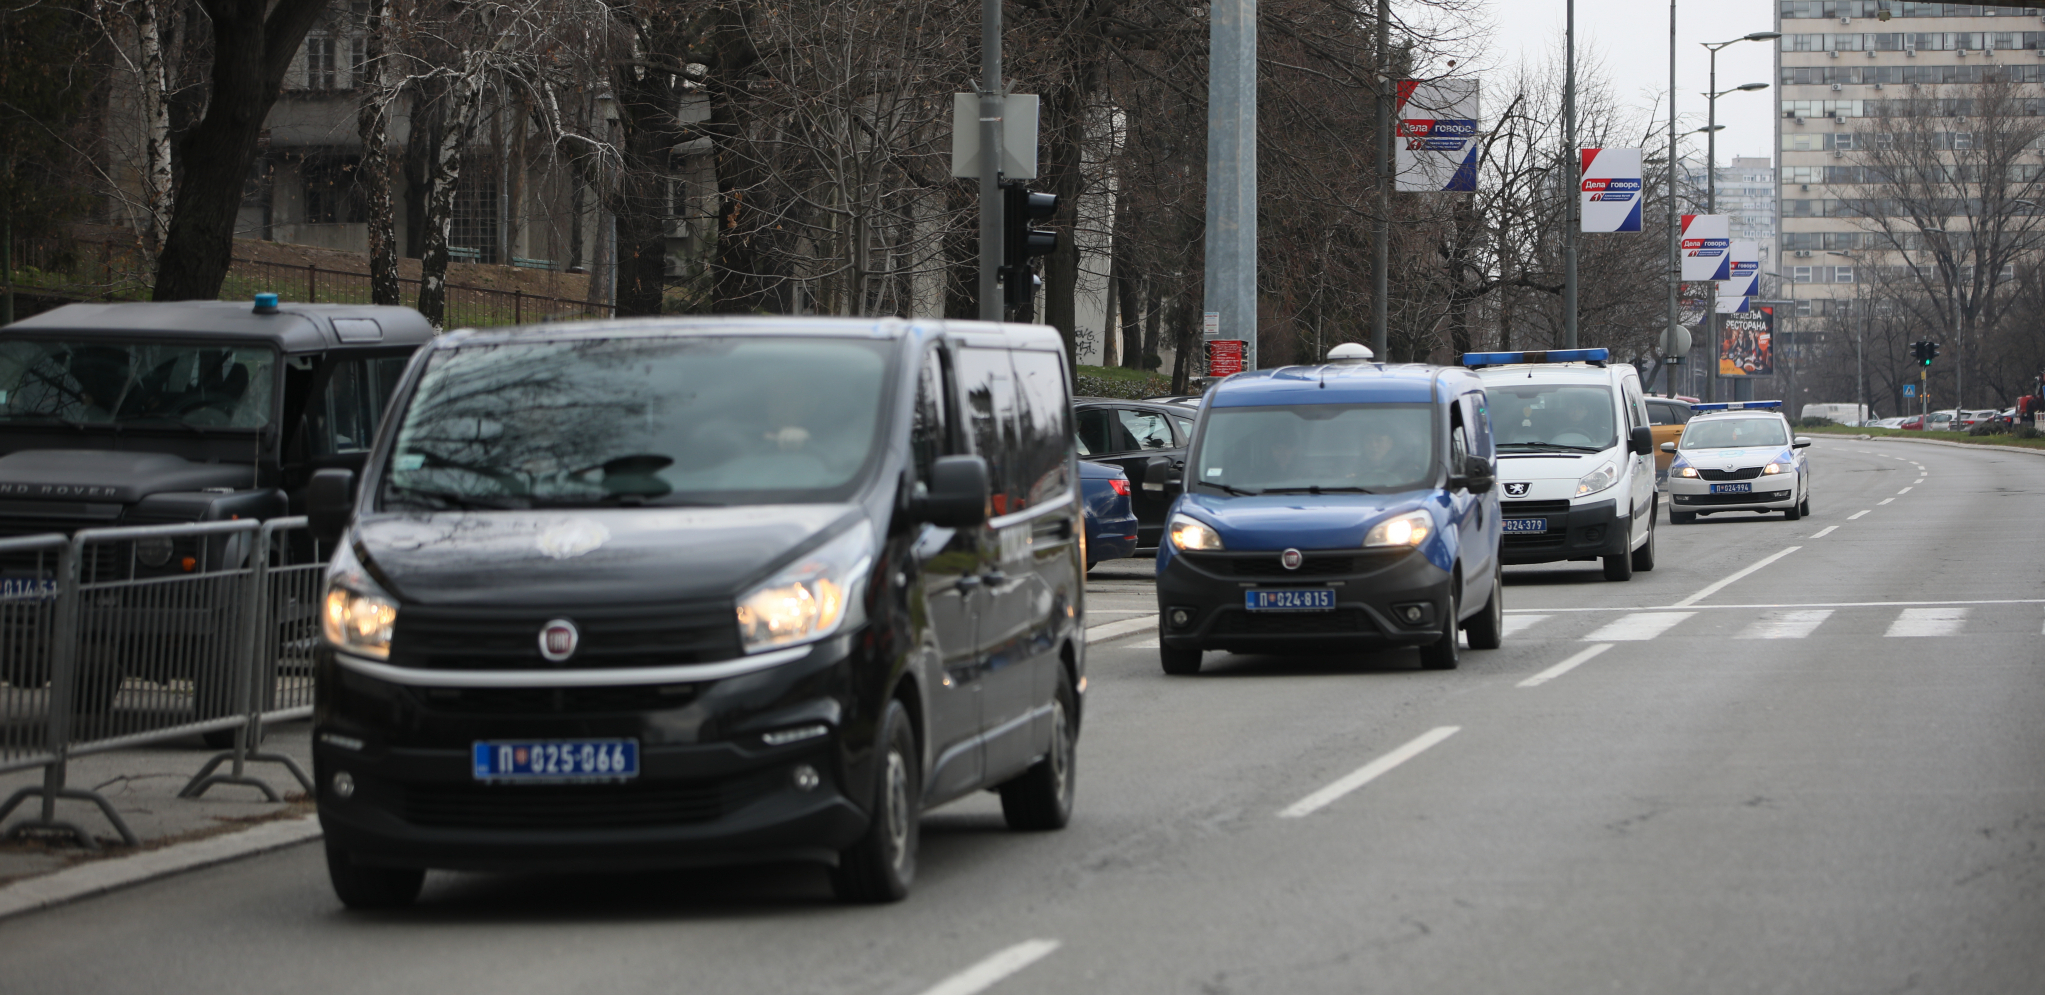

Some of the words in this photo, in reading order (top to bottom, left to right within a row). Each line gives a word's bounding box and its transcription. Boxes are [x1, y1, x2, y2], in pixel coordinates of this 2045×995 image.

[1401, 123, 1428, 133] Дела
[1585, 181, 1606, 189] Дела
[1704, 240, 1728, 248] говоре.
[1726, 320, 1766, 331] РЕСТОРАНА
[0, 484, 29, 493] ND
[41, 485, 117, 496] ROVER
[1724, 484, 1749, 492] 024-994
[1507, 520, 1542, 530] 024-379
[1260, 592, 1268, 607] П
[1277, 591, 1329, 607] 024-815
[498, 744, 514, 773] П
[530, 743, 626, 773] 025-066
